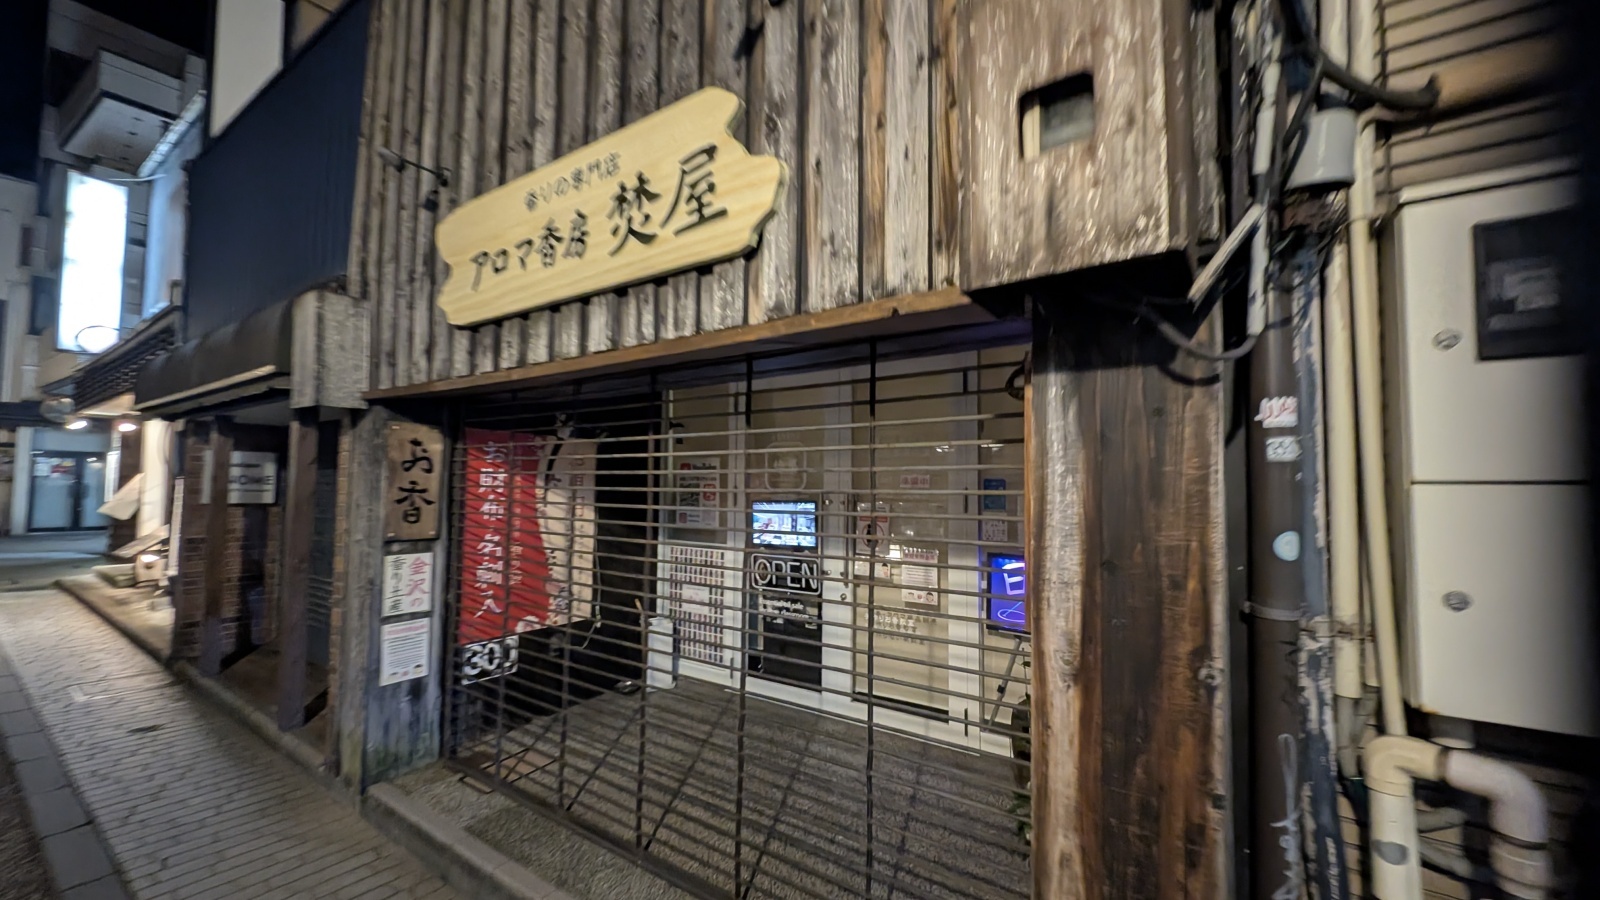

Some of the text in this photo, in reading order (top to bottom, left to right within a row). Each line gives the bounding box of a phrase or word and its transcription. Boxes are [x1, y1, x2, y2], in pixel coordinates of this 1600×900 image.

[524, 151, 621, 212] 香りの専門店
[469, 142, 728, 292] アロマ香房 焚屋
[394, 437, 435, 524] お香
[405, 556, 431, 608] 金沢の
[755, 559, 818, 589] OPEN
